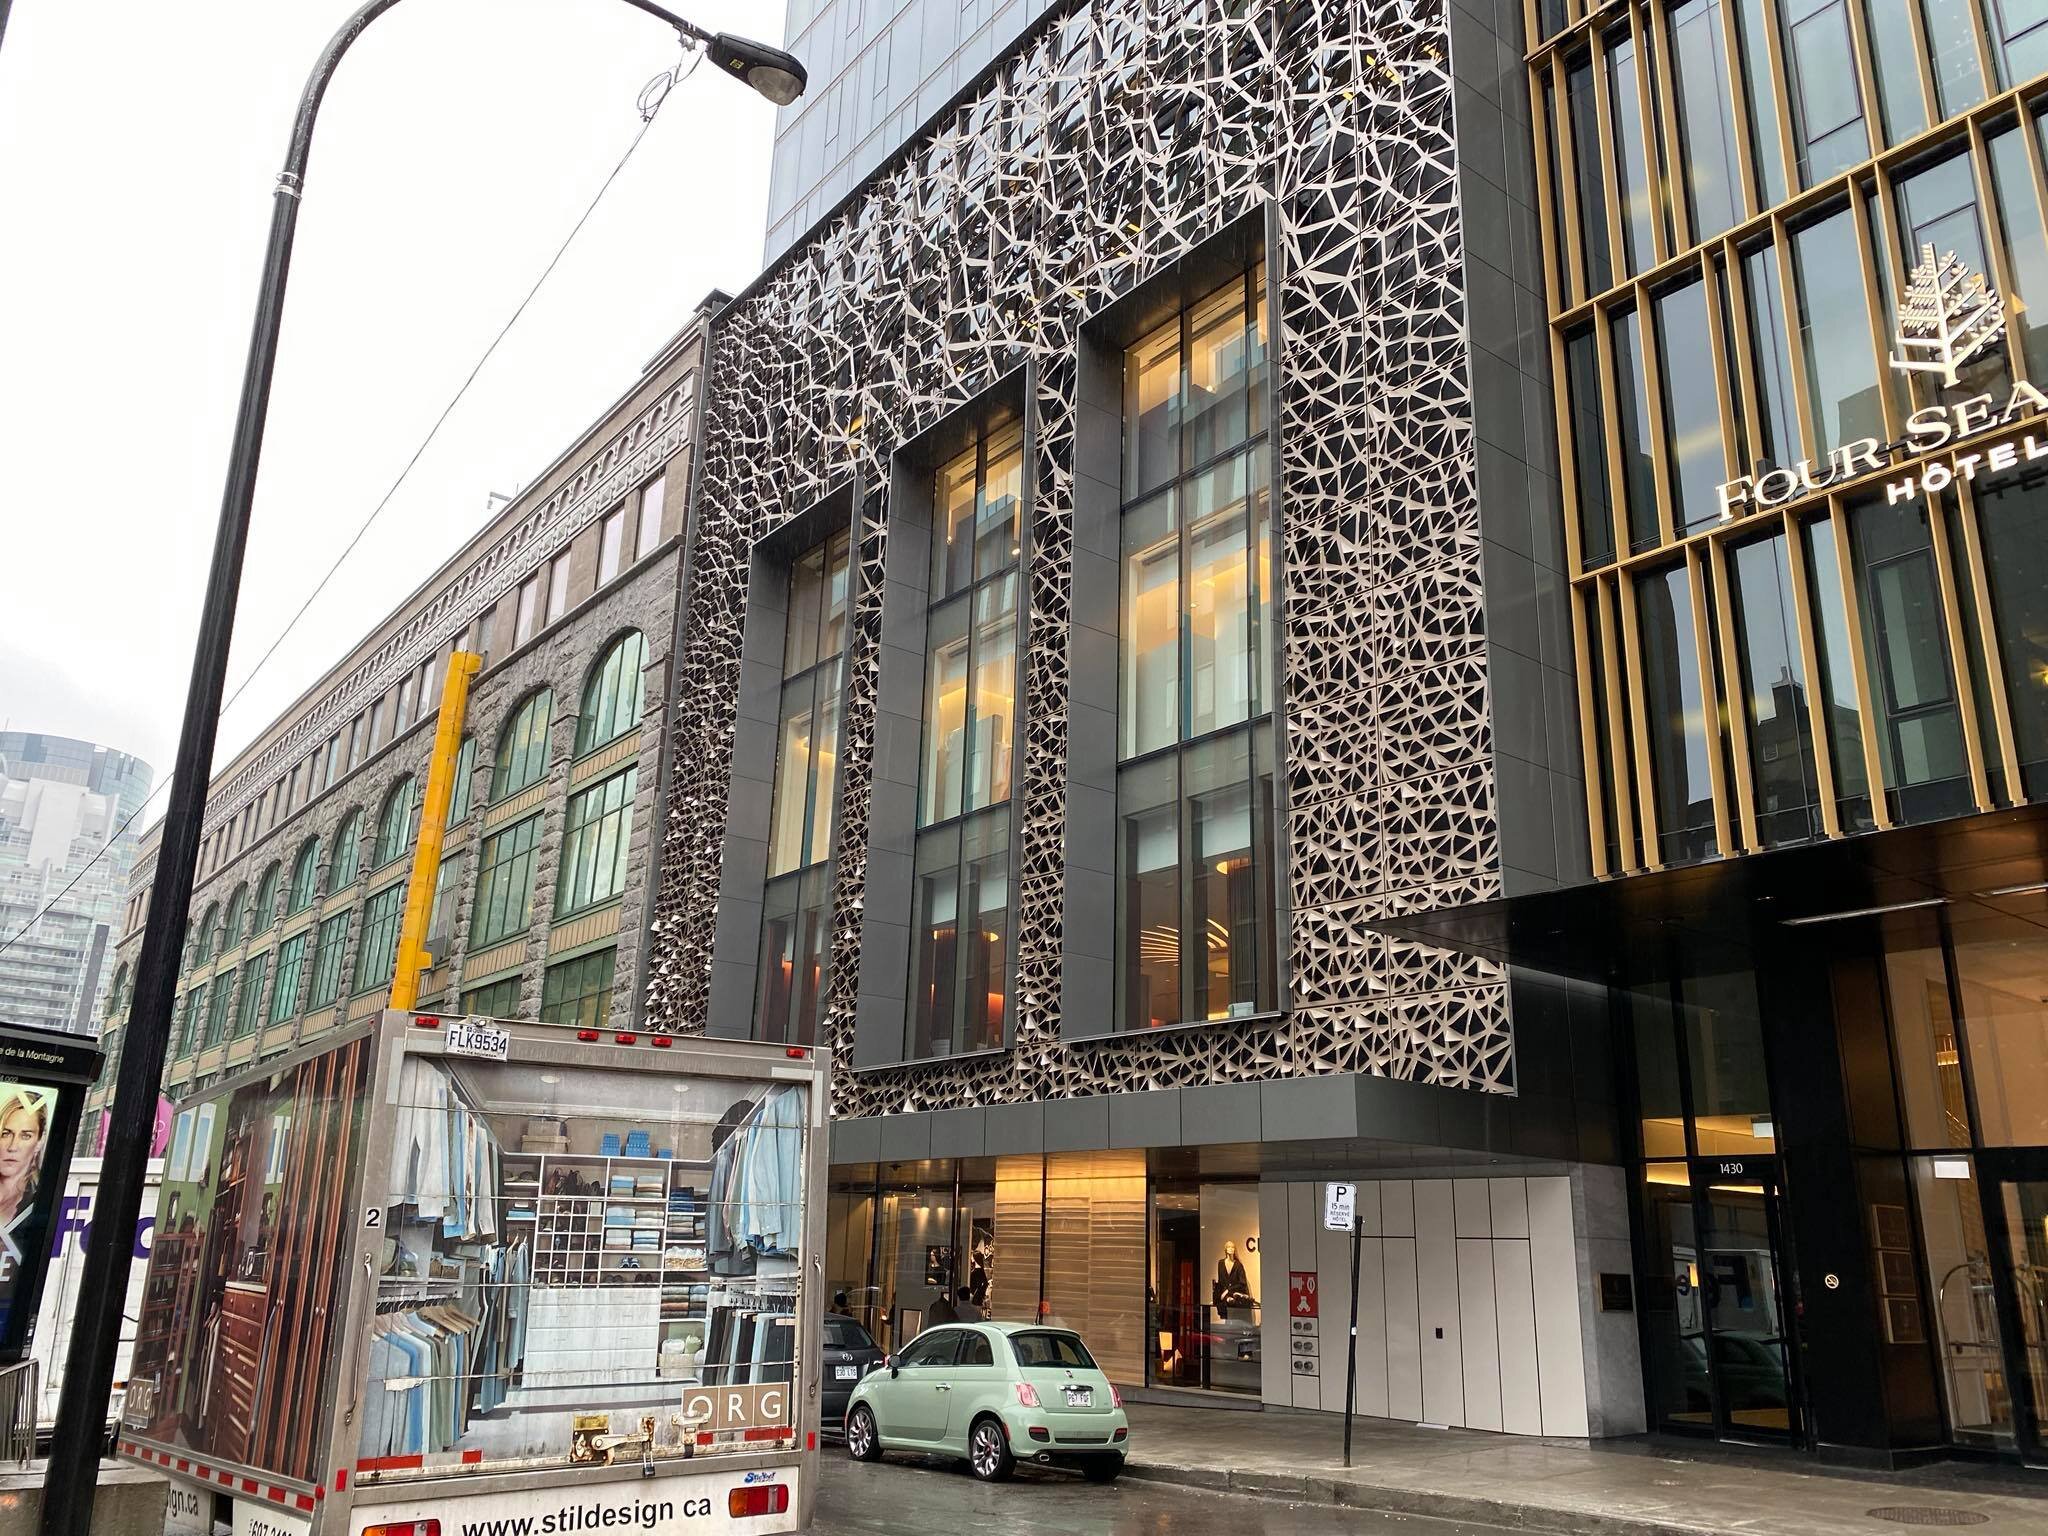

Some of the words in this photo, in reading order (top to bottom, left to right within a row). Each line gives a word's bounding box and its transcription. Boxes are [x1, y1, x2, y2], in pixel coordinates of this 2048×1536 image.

[1715, 437, 1887, 523] FOUR
[449, 1030, 507, 1054] FLK9534
[5, 1047, 15, 1057] de
[17, 1046, 24, 1058] la
[26, 1049, 64, 1064] Montagne
[1720, 1163, 1743, 1174] 1430
[1336, 1186, 1347, 1202] P
[366, 1208, 380, 1227] 2
[462, 1499, 674, 1536] www.stildesign
[683, 1498, 711, 1517] ca
